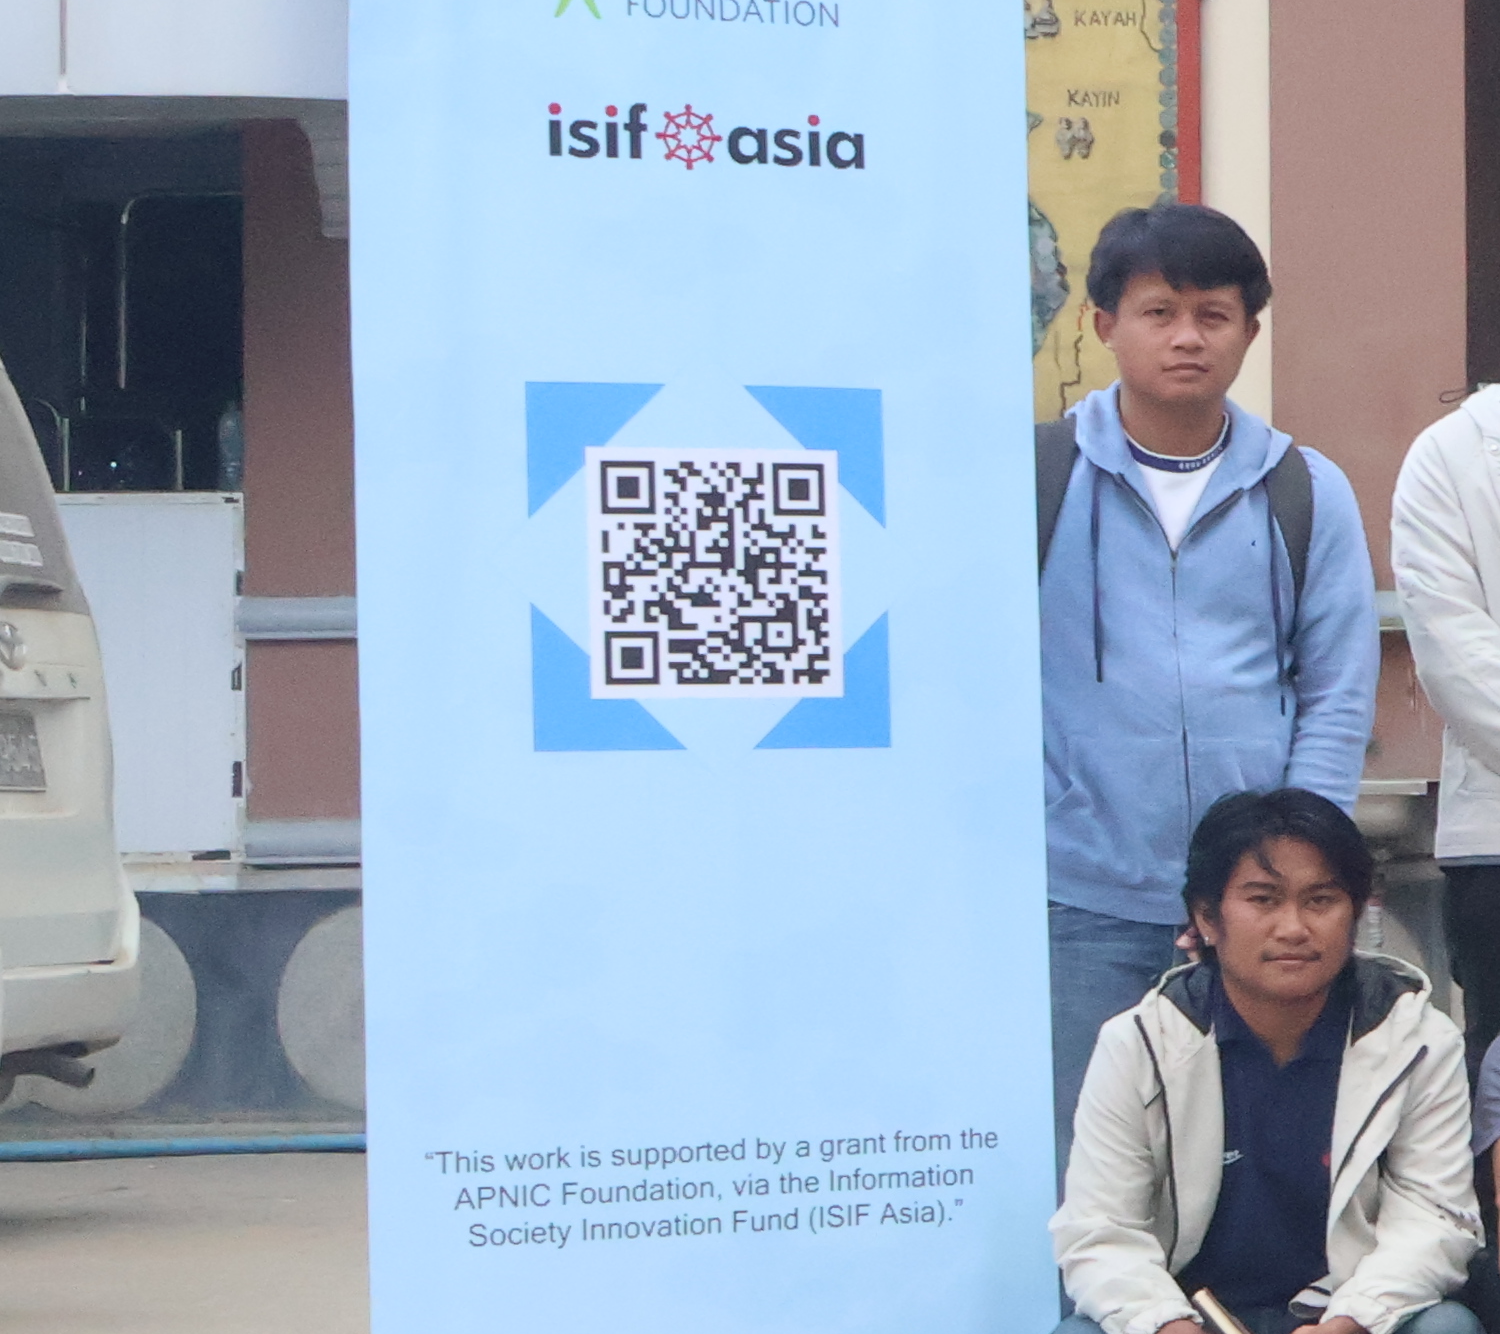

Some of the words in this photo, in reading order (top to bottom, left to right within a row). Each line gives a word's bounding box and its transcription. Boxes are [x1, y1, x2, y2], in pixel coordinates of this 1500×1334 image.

[1073, 9, 1138, 28] KAYAH
[1067, 89, 1121, 109] KAYIN
[424, 1149, 496, 1175] “This
[503, 1145, 572, 1171] work
[580, 1144, 602, 1169] is
[610, 1137, 746, 1170] supported
[755, 1136, 787, 1164] by
[795, 1140, 811, 1159] a
[819, 1133, 887, 1162] grant
[893, 1129, 952, 1155] from
[959, 1127, 999, 1150] the
[453, 1183, 551, 1211] APNIC
[561, 1176, 723, 1205] Foundation,
[732, 1172, 770, 1197] via
[778, 1171, 820, 1194] the
[829, 1163, 974, 1192] Information
[468, 1221, 572, 1250] Society
[582, 1213, 722, 1242] Innovation
[732, 1206, 799, 1234] Fund
[808, 1203, 872, 1235] (ISIF
[879, 1198, 964, 1227] Asia).”
